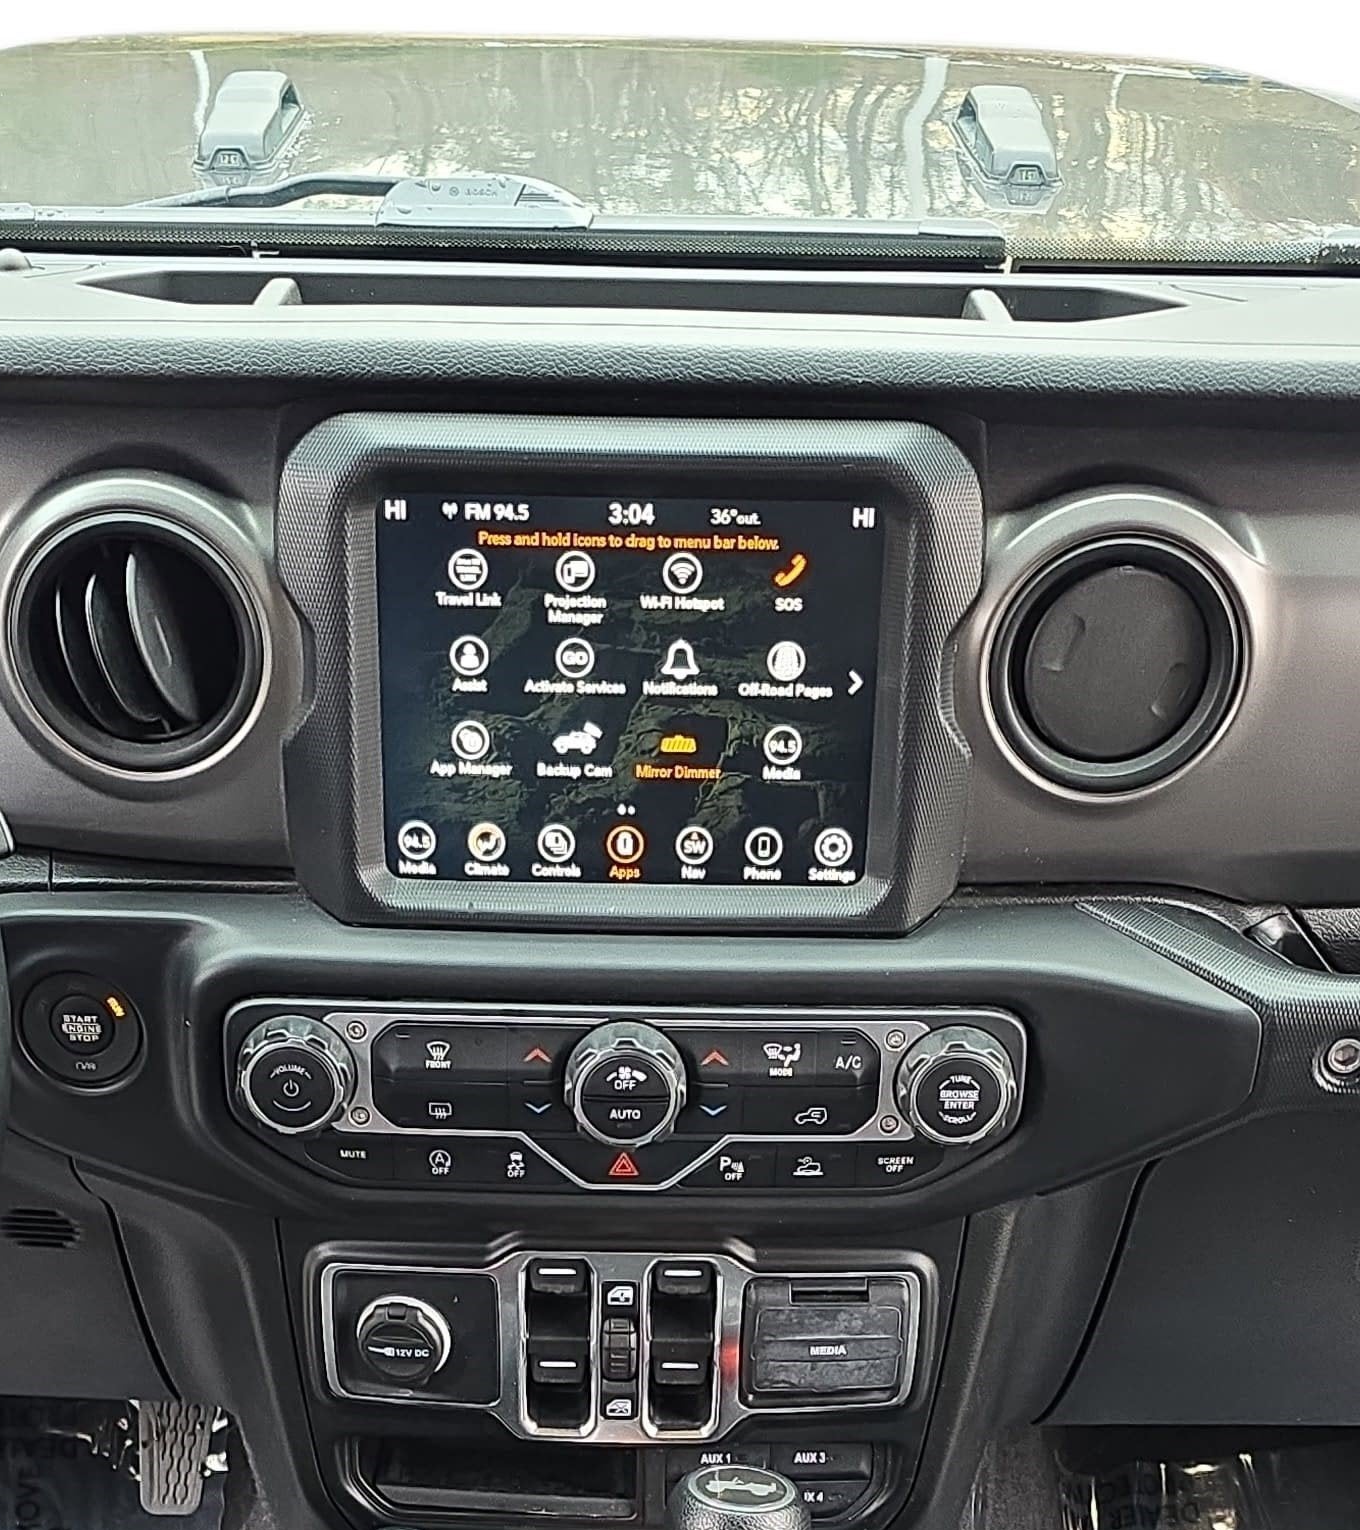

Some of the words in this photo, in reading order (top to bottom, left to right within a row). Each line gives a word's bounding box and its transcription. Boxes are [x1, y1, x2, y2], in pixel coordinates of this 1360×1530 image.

[384, 499, 408, 521] HI
[464, 502, 490, 521] FM
[493, 503, 530, 522] 94.5
[608, 502, 656, 526] 3:04
[851, 506, 876, 529] HI
[478, 530, 512, 546] Press
[513, 531, 540, 546] and
[541, 531, 571, 547] hold
[573, 532, 606, 548] icons
[608, 533, 624, 548] to
[625, 533, 656, 551] drag
[657, 534, 672, 549] to
[673, 535, 711, 550] menu
[713, 534, 737, 550] bar
[738, 535, 780, 551] below.
[435, 590, 474, 607] Travel
[475, 591, 503, 608] Link
[543, 592, 608, 611] Projection
[674, 595, 727, 613] Hotspot
[774, 597, 805, 613] SOS
[547, 609, 605, 627] Manager
[523, 679, 574, 695] Activate
[575, 679, 627, 696] Services
[642, 681, 719, 698] Notifications
[795, 684, 834, 700] Pages
[768, 739, 797, 755] 94.5
[429, 759, 456, 778] App
[458, 761, 515, 779] Manager
[536, 761, 582, 781] Backup
[583, 763, 614, 779] Cam
[635, 763, 673, 779] Mirror
[674, 765, 723, 780] Dimmer
[761, 764, 802, 781] Media
[402, 834, 432, 850] 94.5
[682, 838, 707, 855] SW
[397, 859, 438, 877] Media
[463, 861, 511, 878] Climate
[531, 862, 583, 879] Controls
[608, 865, 641, 881] Apps
[680, 865, 707, 880] Nav
[742, 866, 783, 882] Phone
[807, 867, 857, 884] Settings
[62, 1014, 99, 1023] START
[69, 1034, 100, 1042] STOP
[274, 1063, 306, 1076] VOLUME
[425, 1059, 452, 1070] FRONT
[834, 1054, 863, 1071] A/C
[768, 1066, 794, 1078] MODE
[613, 1079, 637, 1092] OFF
[940, 1089, 980, 1099] BROWSE
[943, 1101, 975, 1110] ENTER
[608, 1108, 641, 1121] AUTO
[339, 1149, 368, 1160] MUTE
[877, 1155, 915, 1166] SCREEN
[431, 1165, 450, 1176] OFF
[506, 1168, 525, 1178] OFF
[724, 1171, 743, 1182] OFF
[885, 1164, 905, 1174] OFF
[395, 1348, 413, 1358] 12V
[414, 1348, 430, 1358] DC
[809, 1343, 848, 1358] MEDIA
[700, 1452, 724, 1465] AUX
[794, 1451, 818, 1464] AUX
